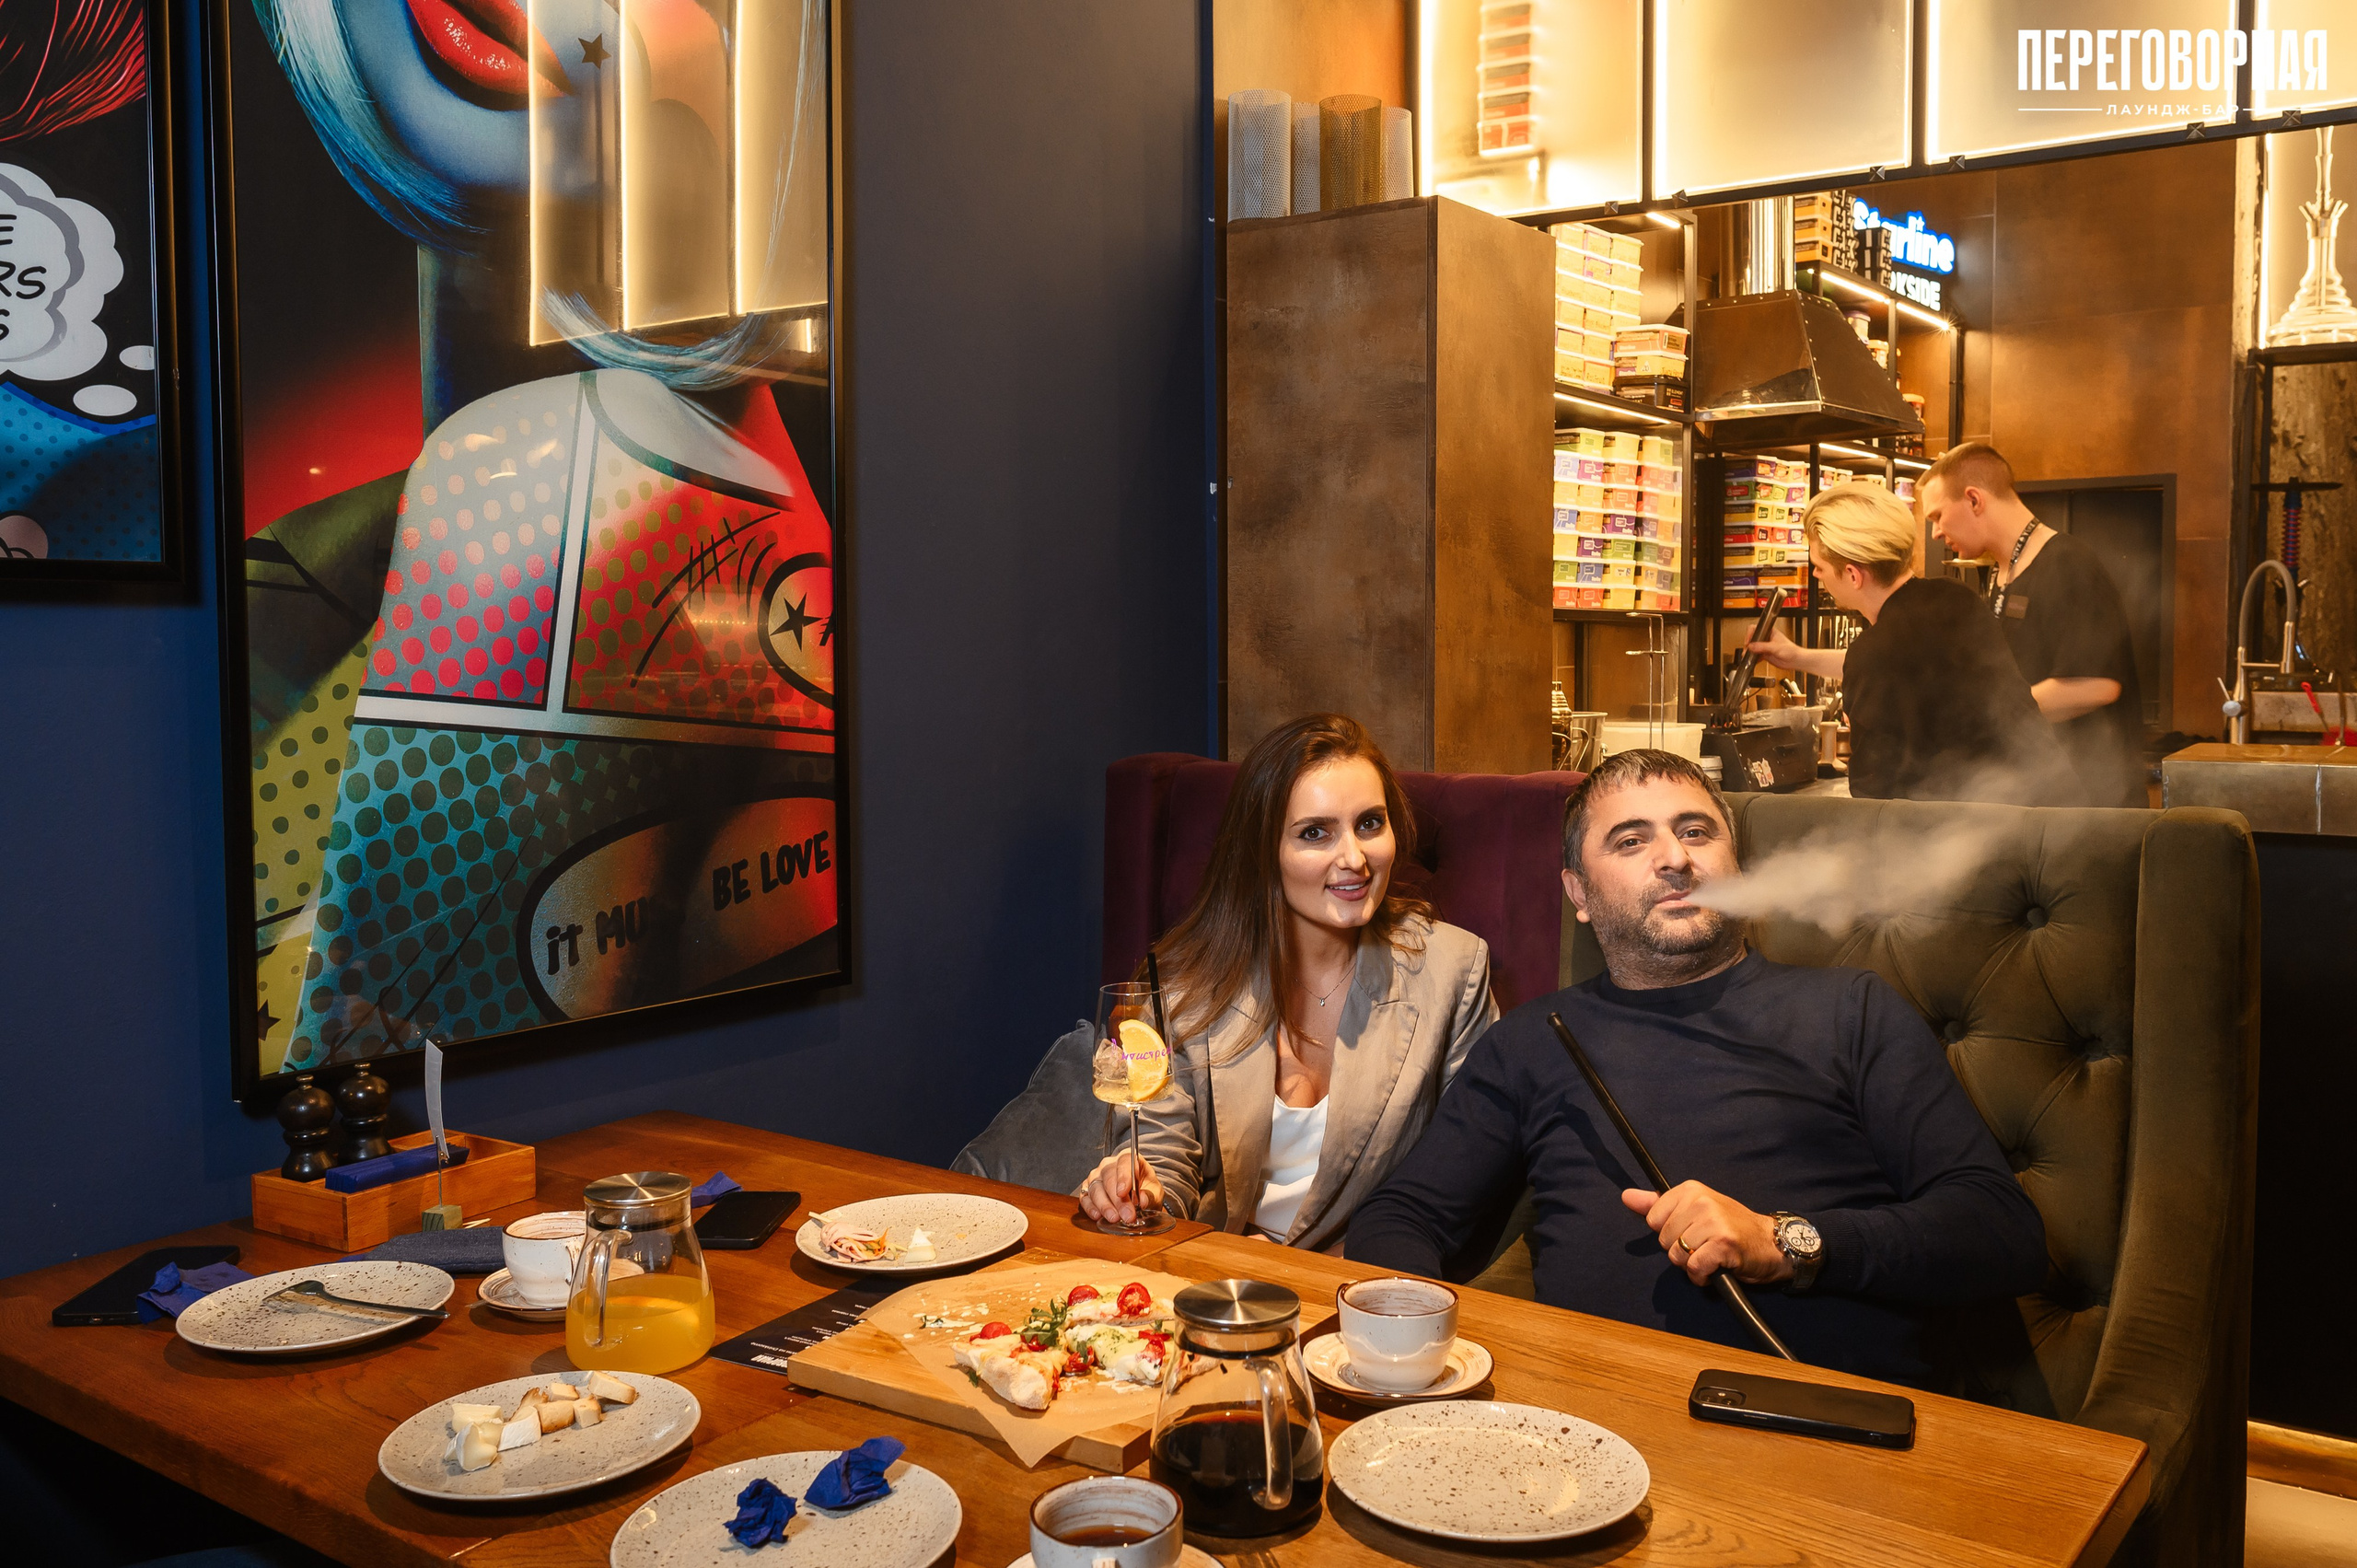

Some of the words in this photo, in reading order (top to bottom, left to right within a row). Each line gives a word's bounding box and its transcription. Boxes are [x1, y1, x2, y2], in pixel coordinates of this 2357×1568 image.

[1890, 271, 1941, 312] KSIDE
[595, 897, 654, 956] MU
[712, 858, 751, 912] BE
[760, 830, 831, 894] LOVE
